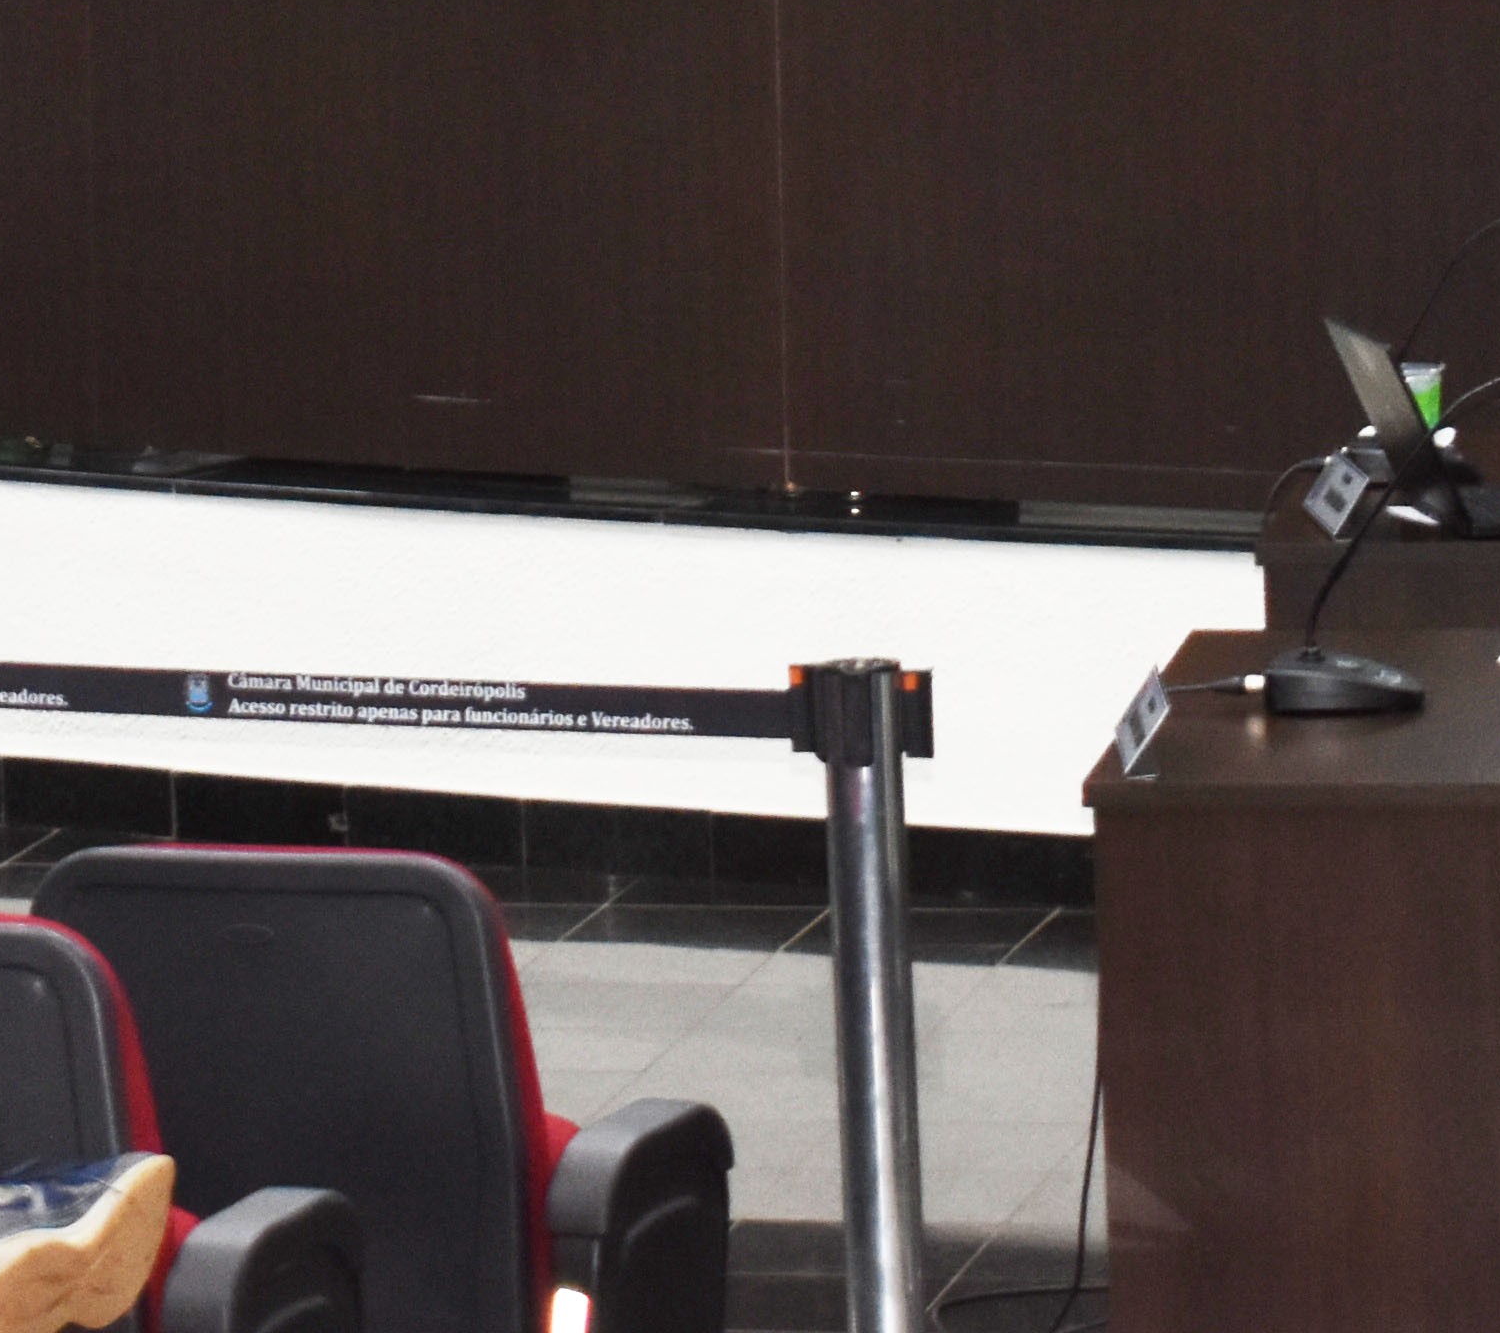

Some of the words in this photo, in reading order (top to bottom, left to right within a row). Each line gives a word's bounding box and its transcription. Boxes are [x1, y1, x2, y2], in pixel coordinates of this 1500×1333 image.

[228, 672, 292, 691] Câmara
[296, 674, 379, 697] Municipal
[383, 677, 404, 695] de
[409, 679, 525, 702] Cordeirópolis
[229, 697, 285, 715] Acesso
[289, 700, 354, 719] restrito
[357, 705, 417, 724] apenas
[422, 707, 460, 726] para
[464, 705, 574, 727] funcionários
[577, 714, 587, 727] e
[591, 711, 694, 731] Vereadores.
